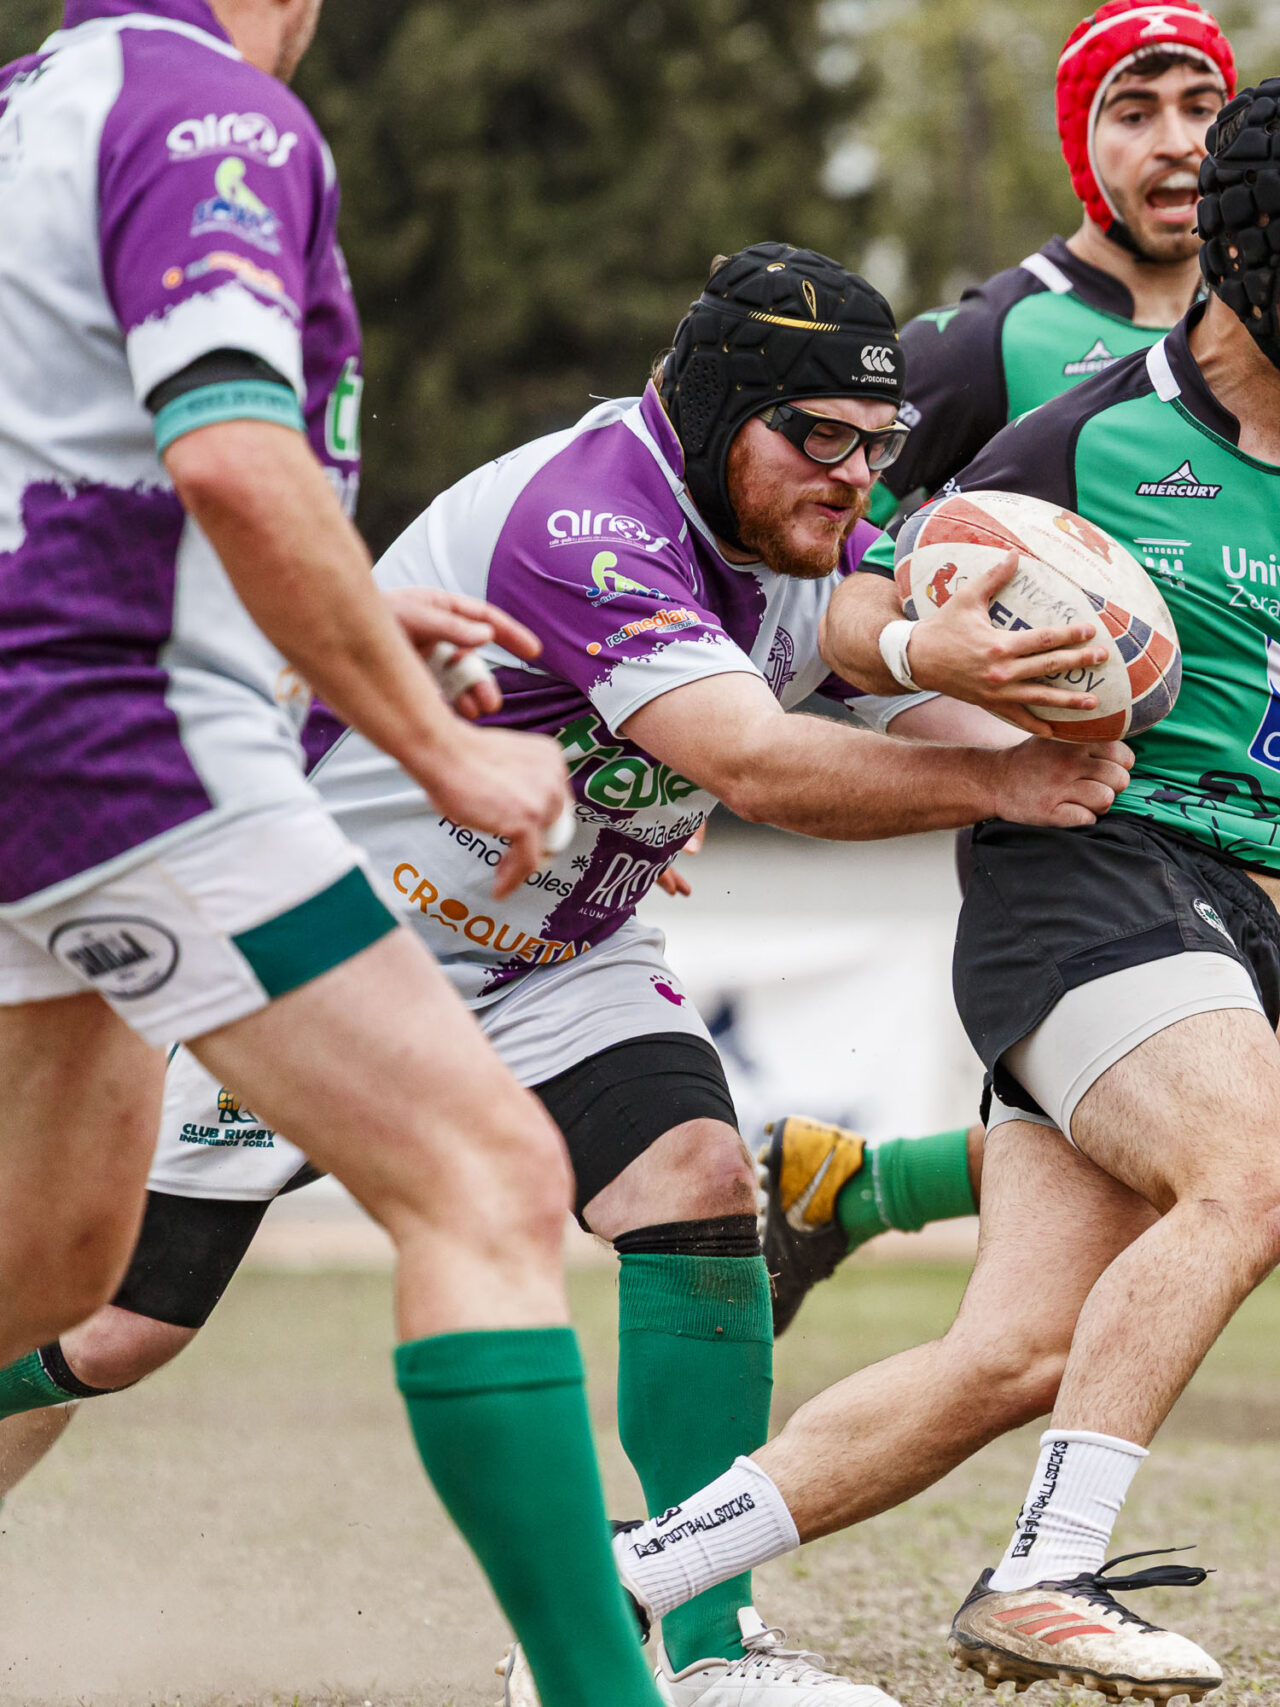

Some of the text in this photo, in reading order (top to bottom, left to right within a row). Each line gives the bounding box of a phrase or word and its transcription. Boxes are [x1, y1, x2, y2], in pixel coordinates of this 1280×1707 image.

[1137, 483, 1220, 497] MERCURY
[182, 1123, 275, 1141] CLUB RUGBY
[179, 1134, 275, 1148] INGENIEROS SORIA
[658, 1492, 756, 1549] FOOTBALLSOCKS
